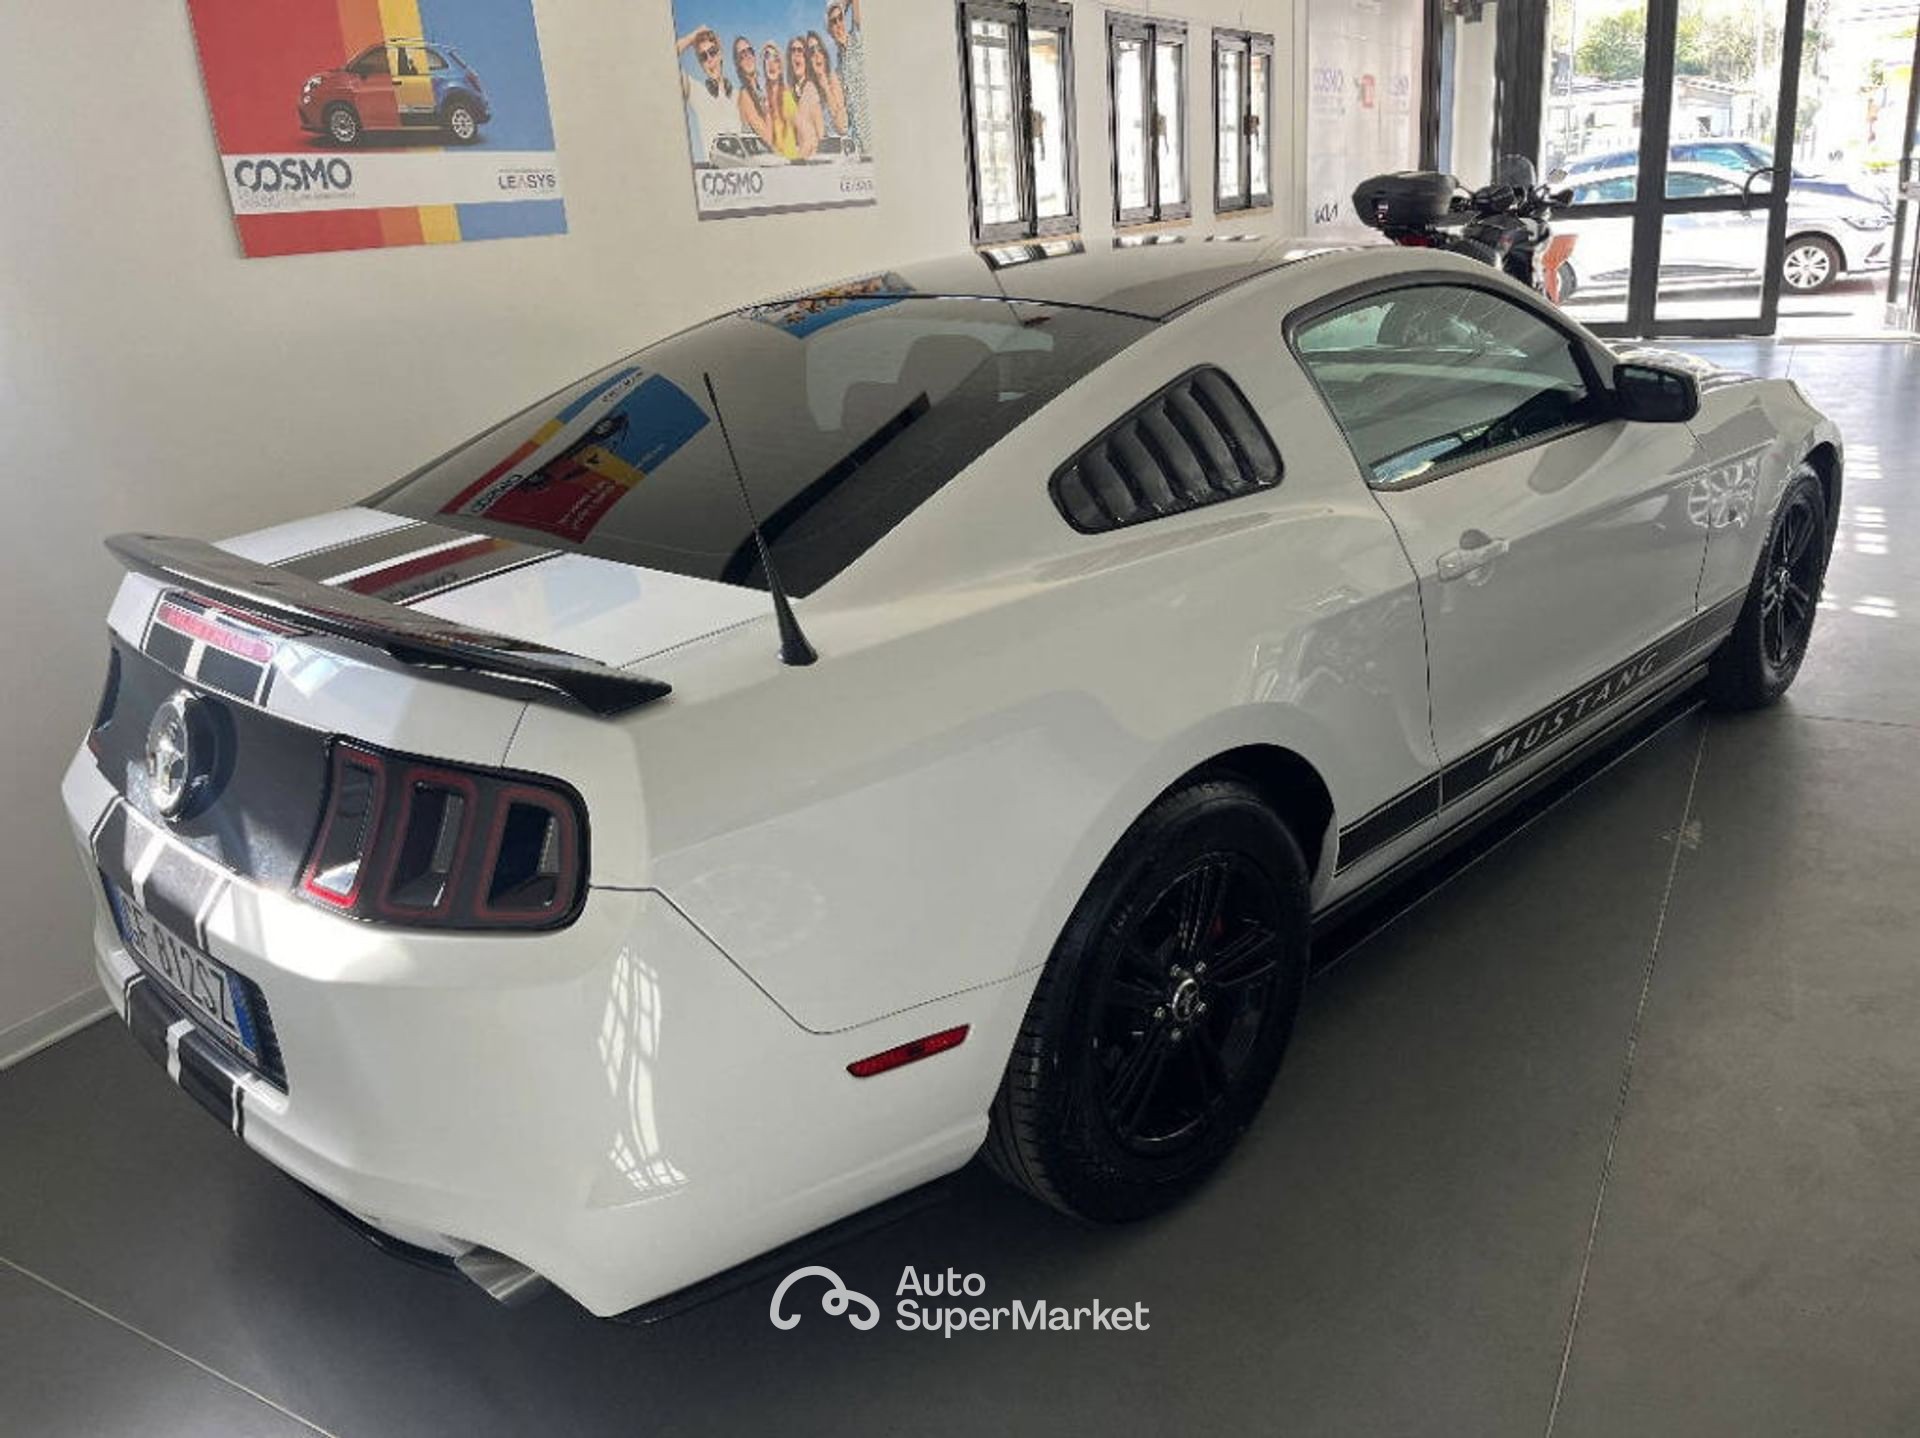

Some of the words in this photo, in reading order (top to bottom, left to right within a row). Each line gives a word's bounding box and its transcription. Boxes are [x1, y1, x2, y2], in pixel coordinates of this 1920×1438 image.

[234, 157, 352, 192] COSMO
[498, 174, 556, 190] LEASYS
[701, 170, 764, 196] COSMO
[1488, 651, 1659, 771] MUSTANG
[152, 918, 236, 1030] 812SZ
